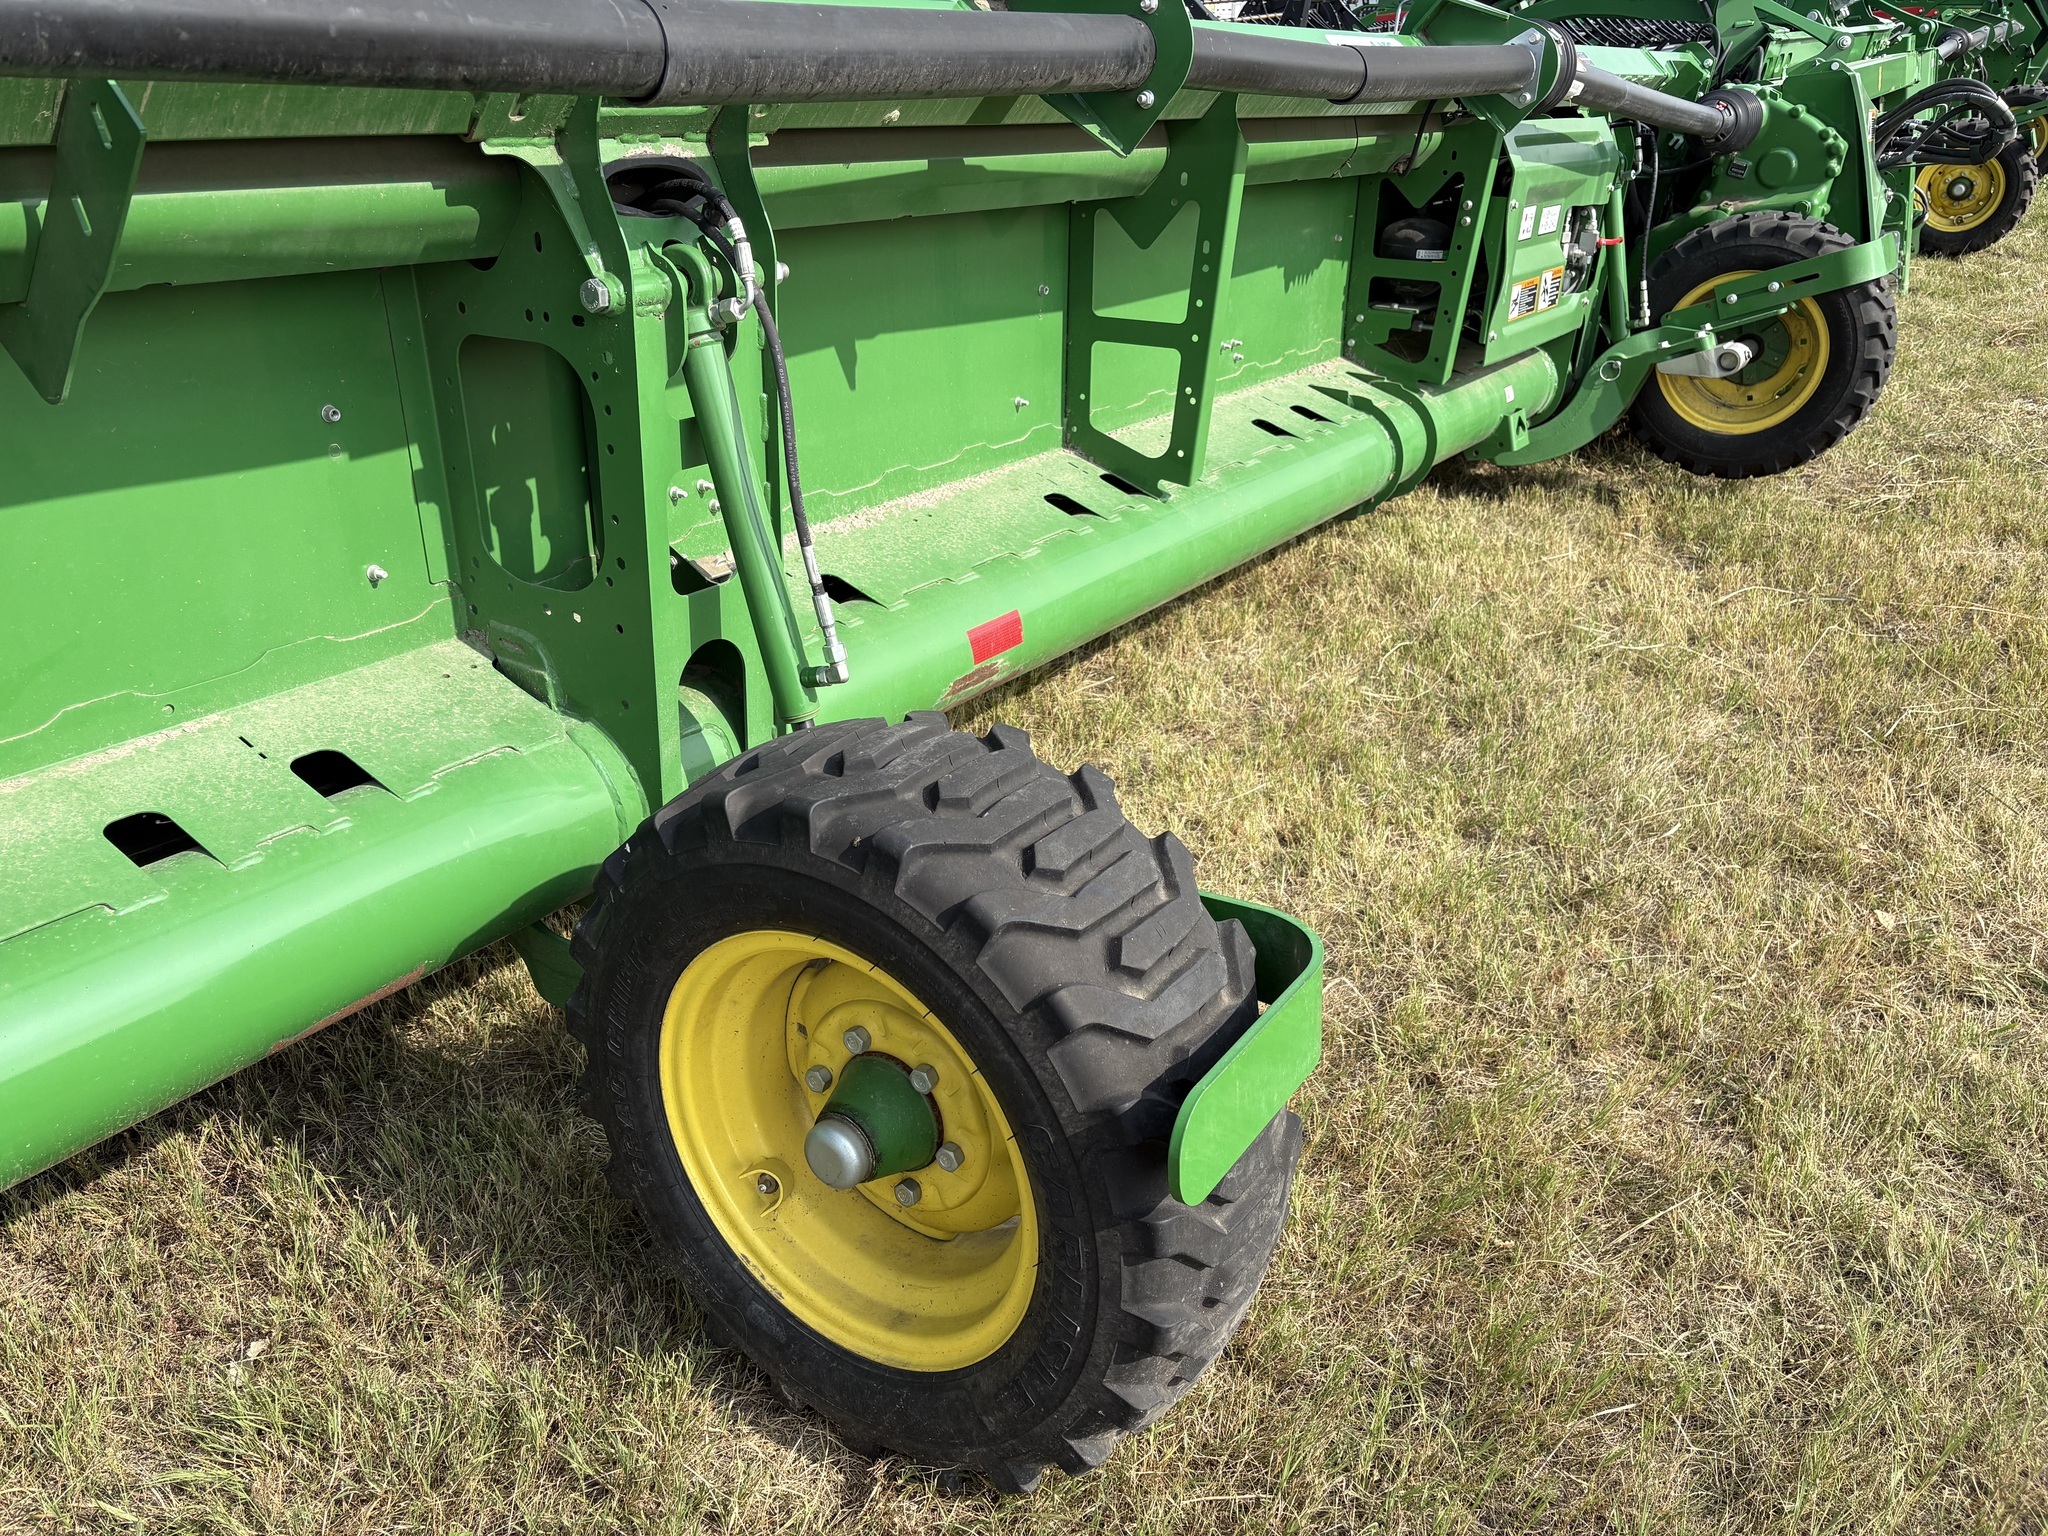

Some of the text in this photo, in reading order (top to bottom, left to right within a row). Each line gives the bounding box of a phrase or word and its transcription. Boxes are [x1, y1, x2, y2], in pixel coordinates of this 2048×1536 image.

[605, 937, 654, 1188] TRAC CHIEF
[1015, 1123, 1084, 1418] CARLISLE
